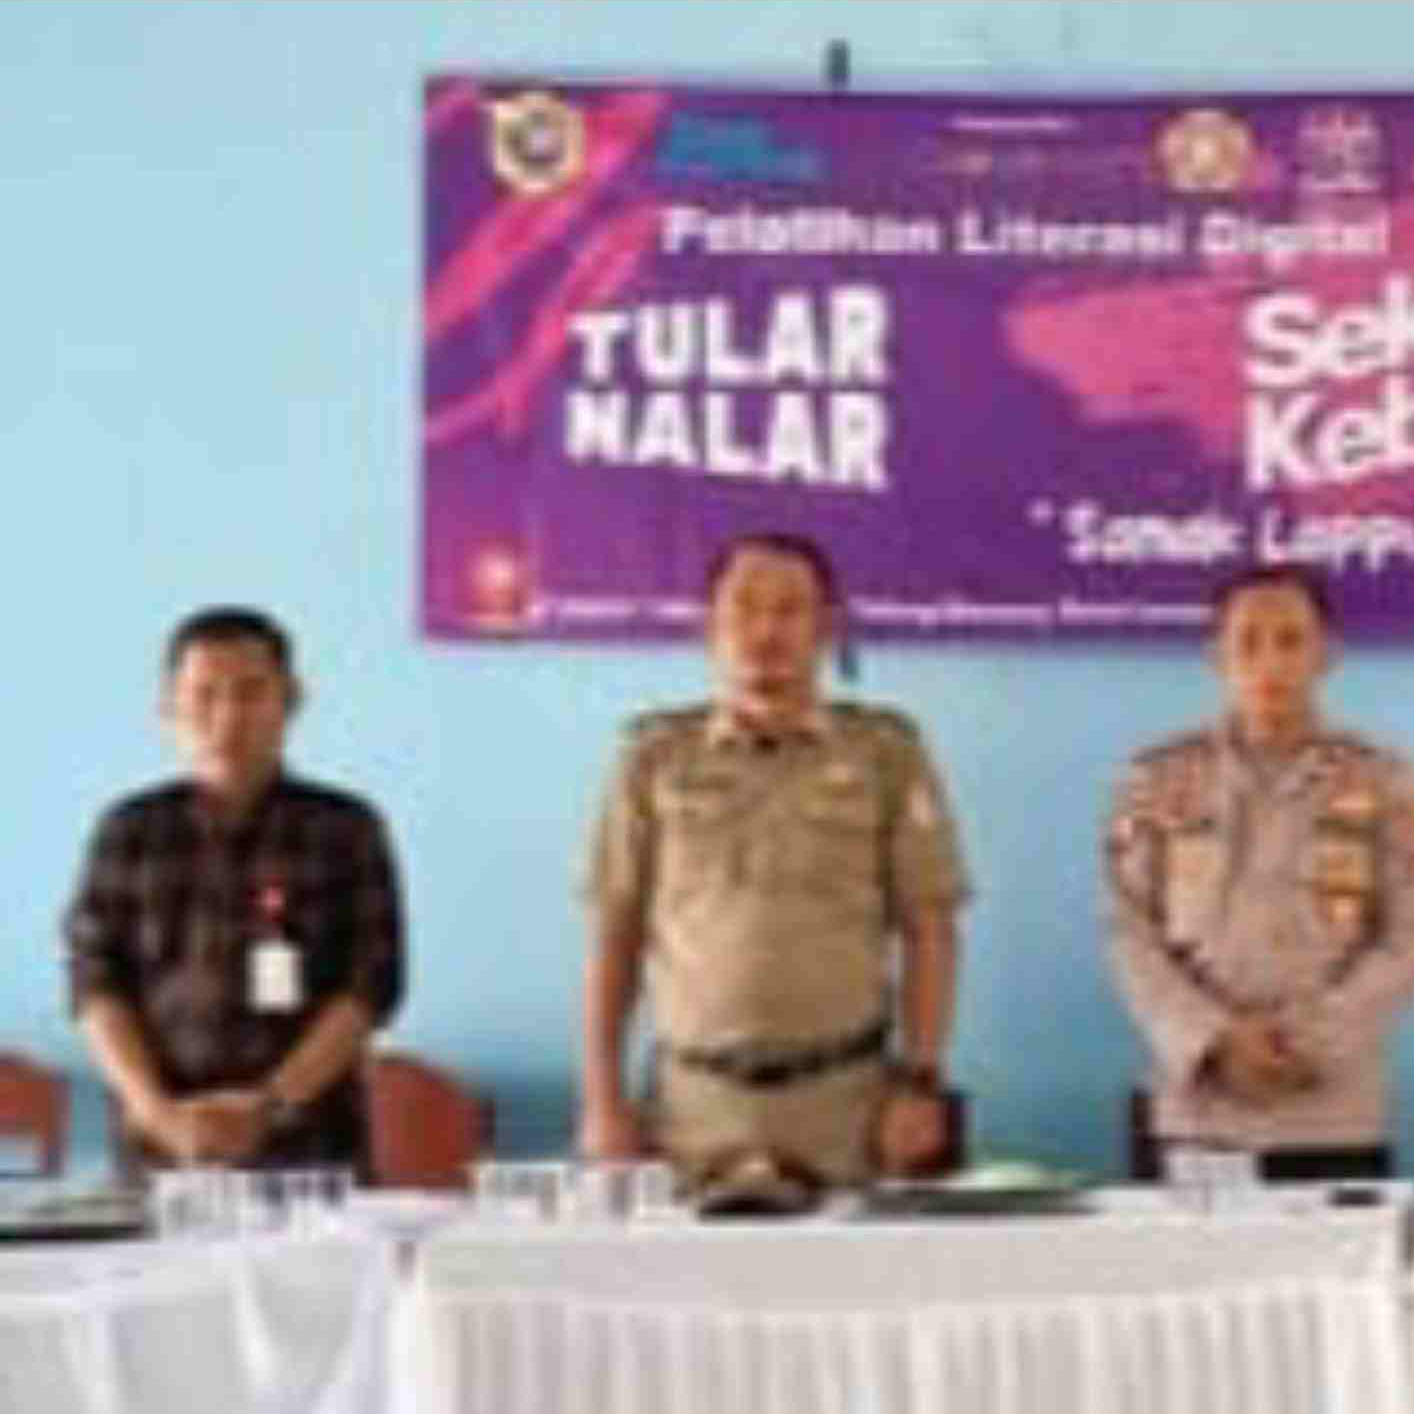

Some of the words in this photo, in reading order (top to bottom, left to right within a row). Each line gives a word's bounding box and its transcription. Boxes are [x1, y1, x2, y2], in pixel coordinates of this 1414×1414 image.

[660, 204, 942, 256] Pelatihan
[960, 200, 1184, 256] Literasi
[1200, 208, 1391, 274] Digital
[568, 286, 890, 384] TULAR
[565, 388, 890, 492] NALAR
